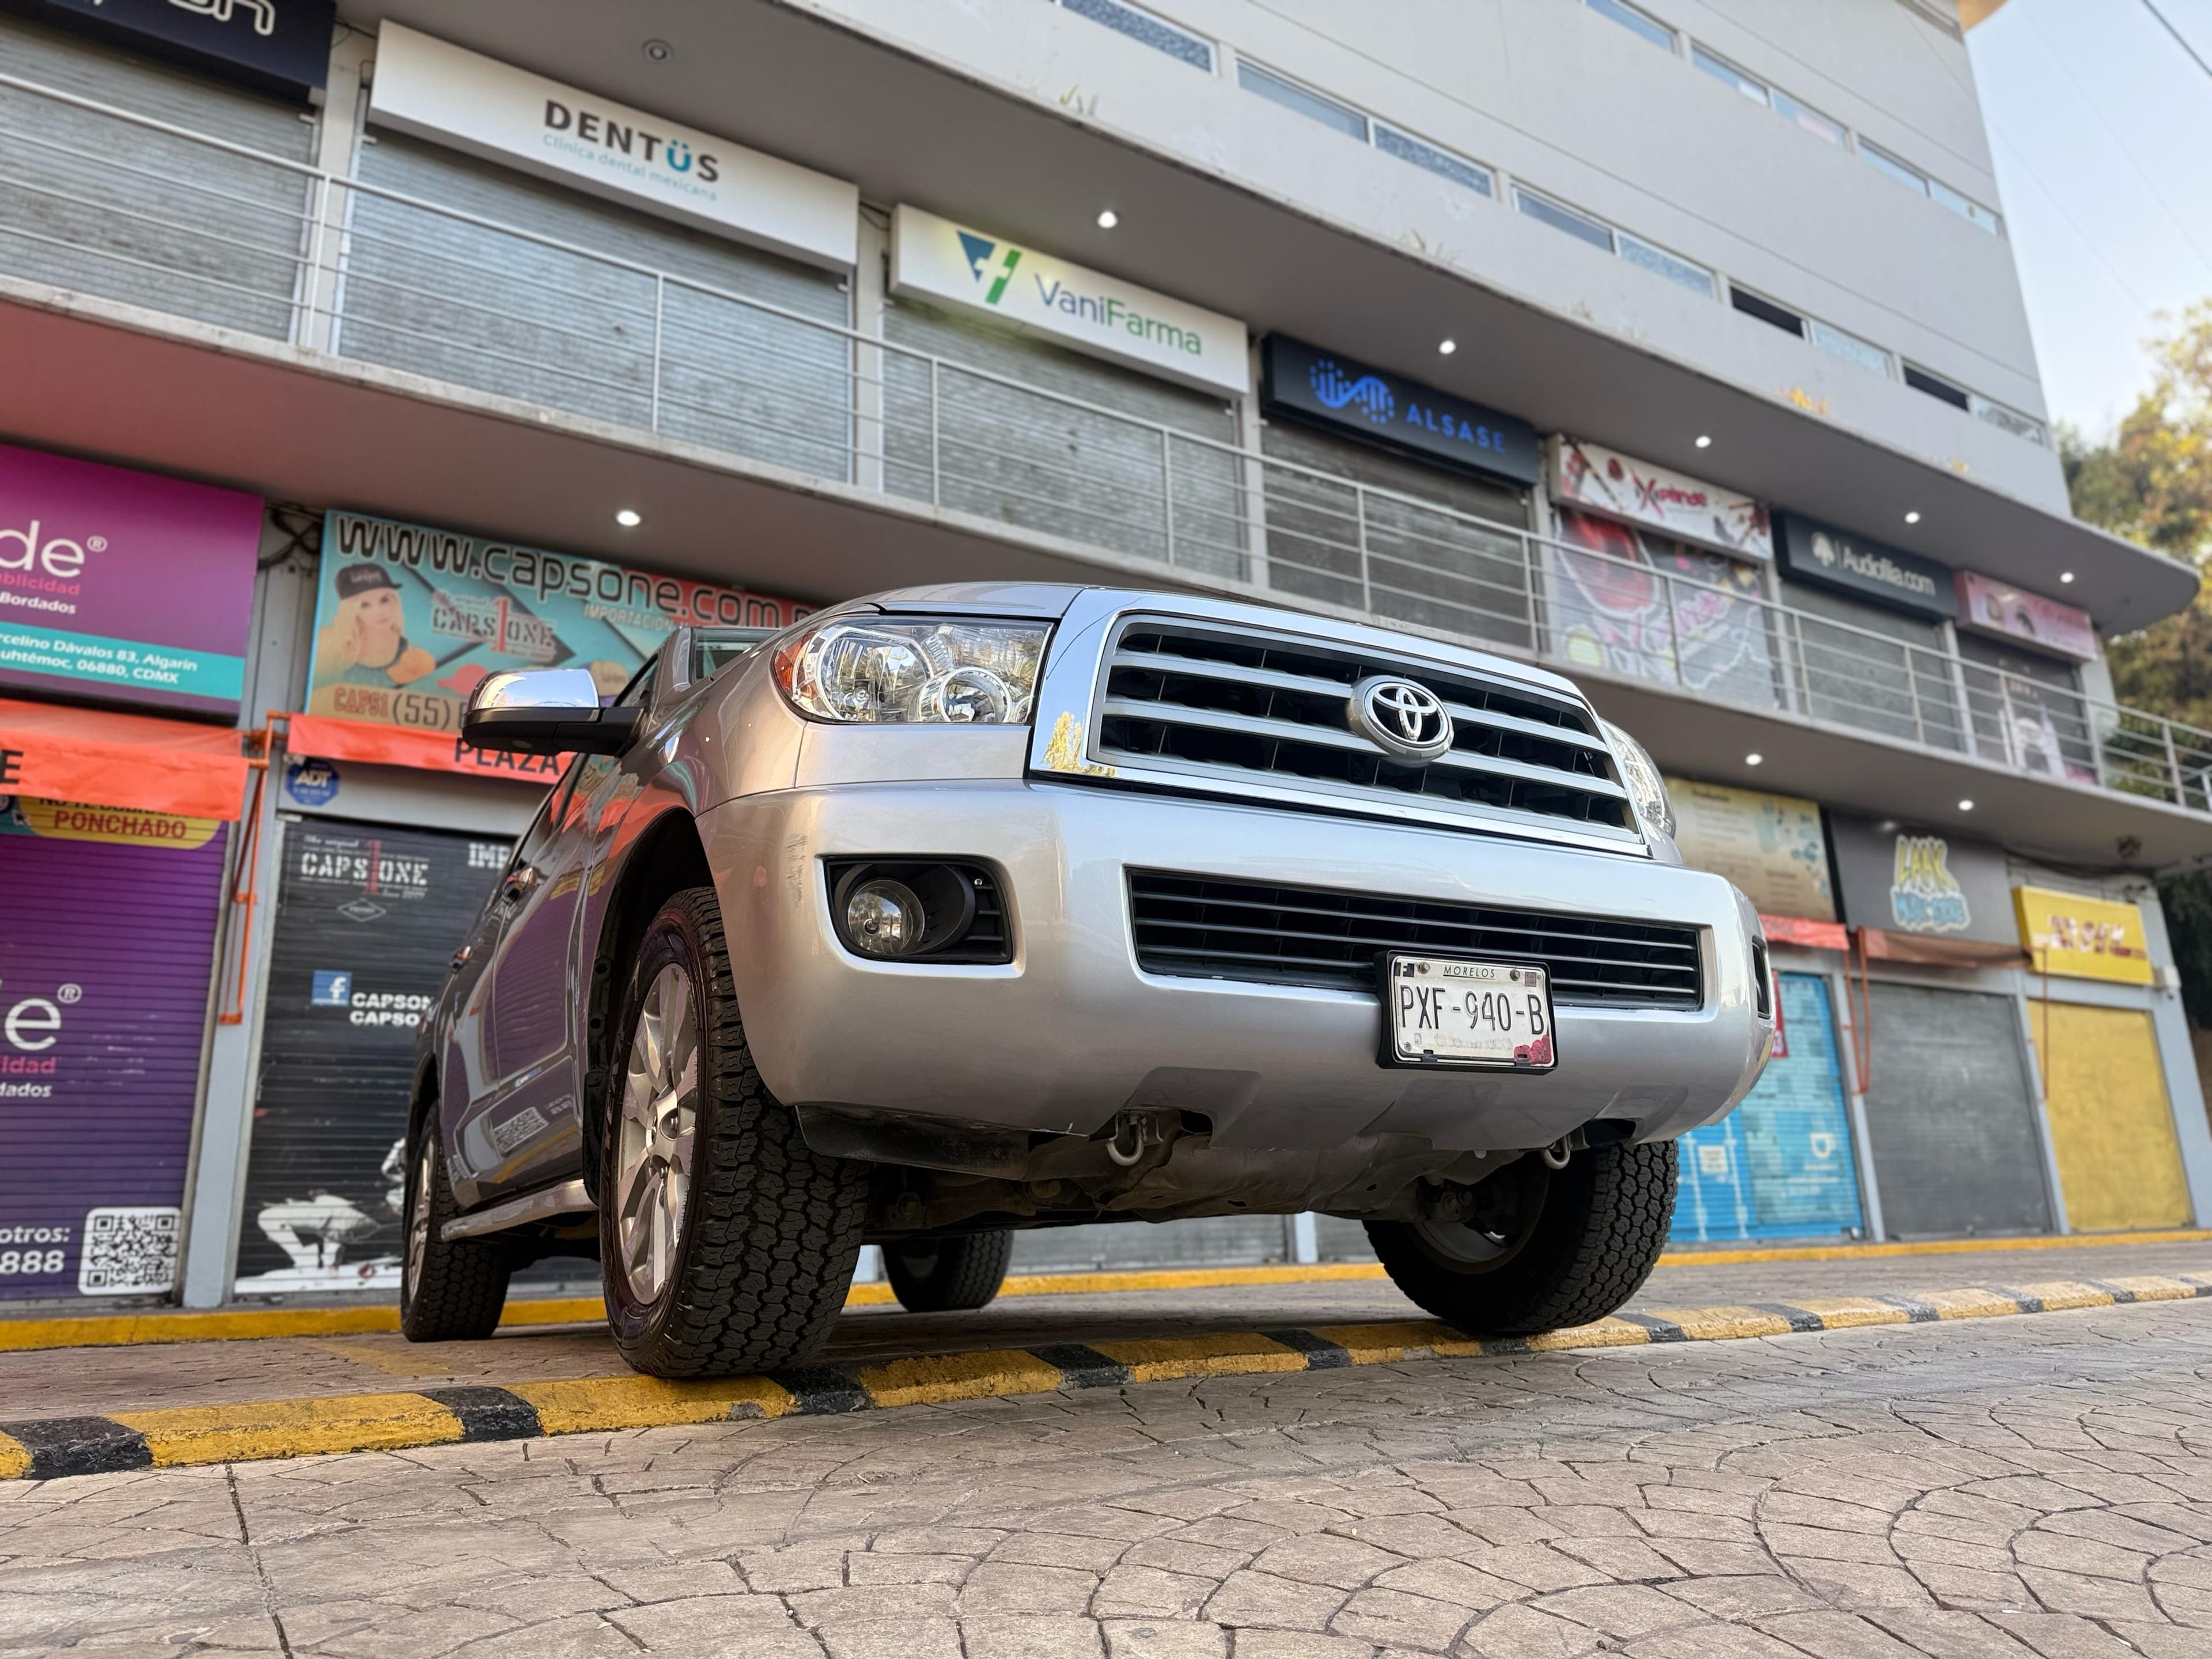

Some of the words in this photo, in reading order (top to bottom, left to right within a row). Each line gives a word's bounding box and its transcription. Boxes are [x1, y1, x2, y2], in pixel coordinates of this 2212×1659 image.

[544, 99, 719, 183] DENTÜS
[597, 152, 647, 179] dental
[649, 171, 717, 202] mexicana
[1033, 272, 1203, 356] VaniFarma
[1405, 403, 1508, 453] ALSASE
[0, 574, 81, 596] blicidad
[1, 591, 77, 615] Bordados
[52, 639, 113, 660] Dávalos
[116, 649, 140, 664] 83,
[77, 658, 129, 679] 06880,
[132, 666, 179, 684] CDMX
[393, 693, 451, 732] (55)
[454, 737, 559, 776] PLAZA
[296, 770, 331, 788] ADT
[54, 809, 187, 840] PONCHADO
[1443, 965, 1495, 978] MORELOS
[1400, 984, 1545, 1035] PXF-940-B
[0, 1225, 71, 1244] otros:
[0, 1249, 66, 1275] 888
